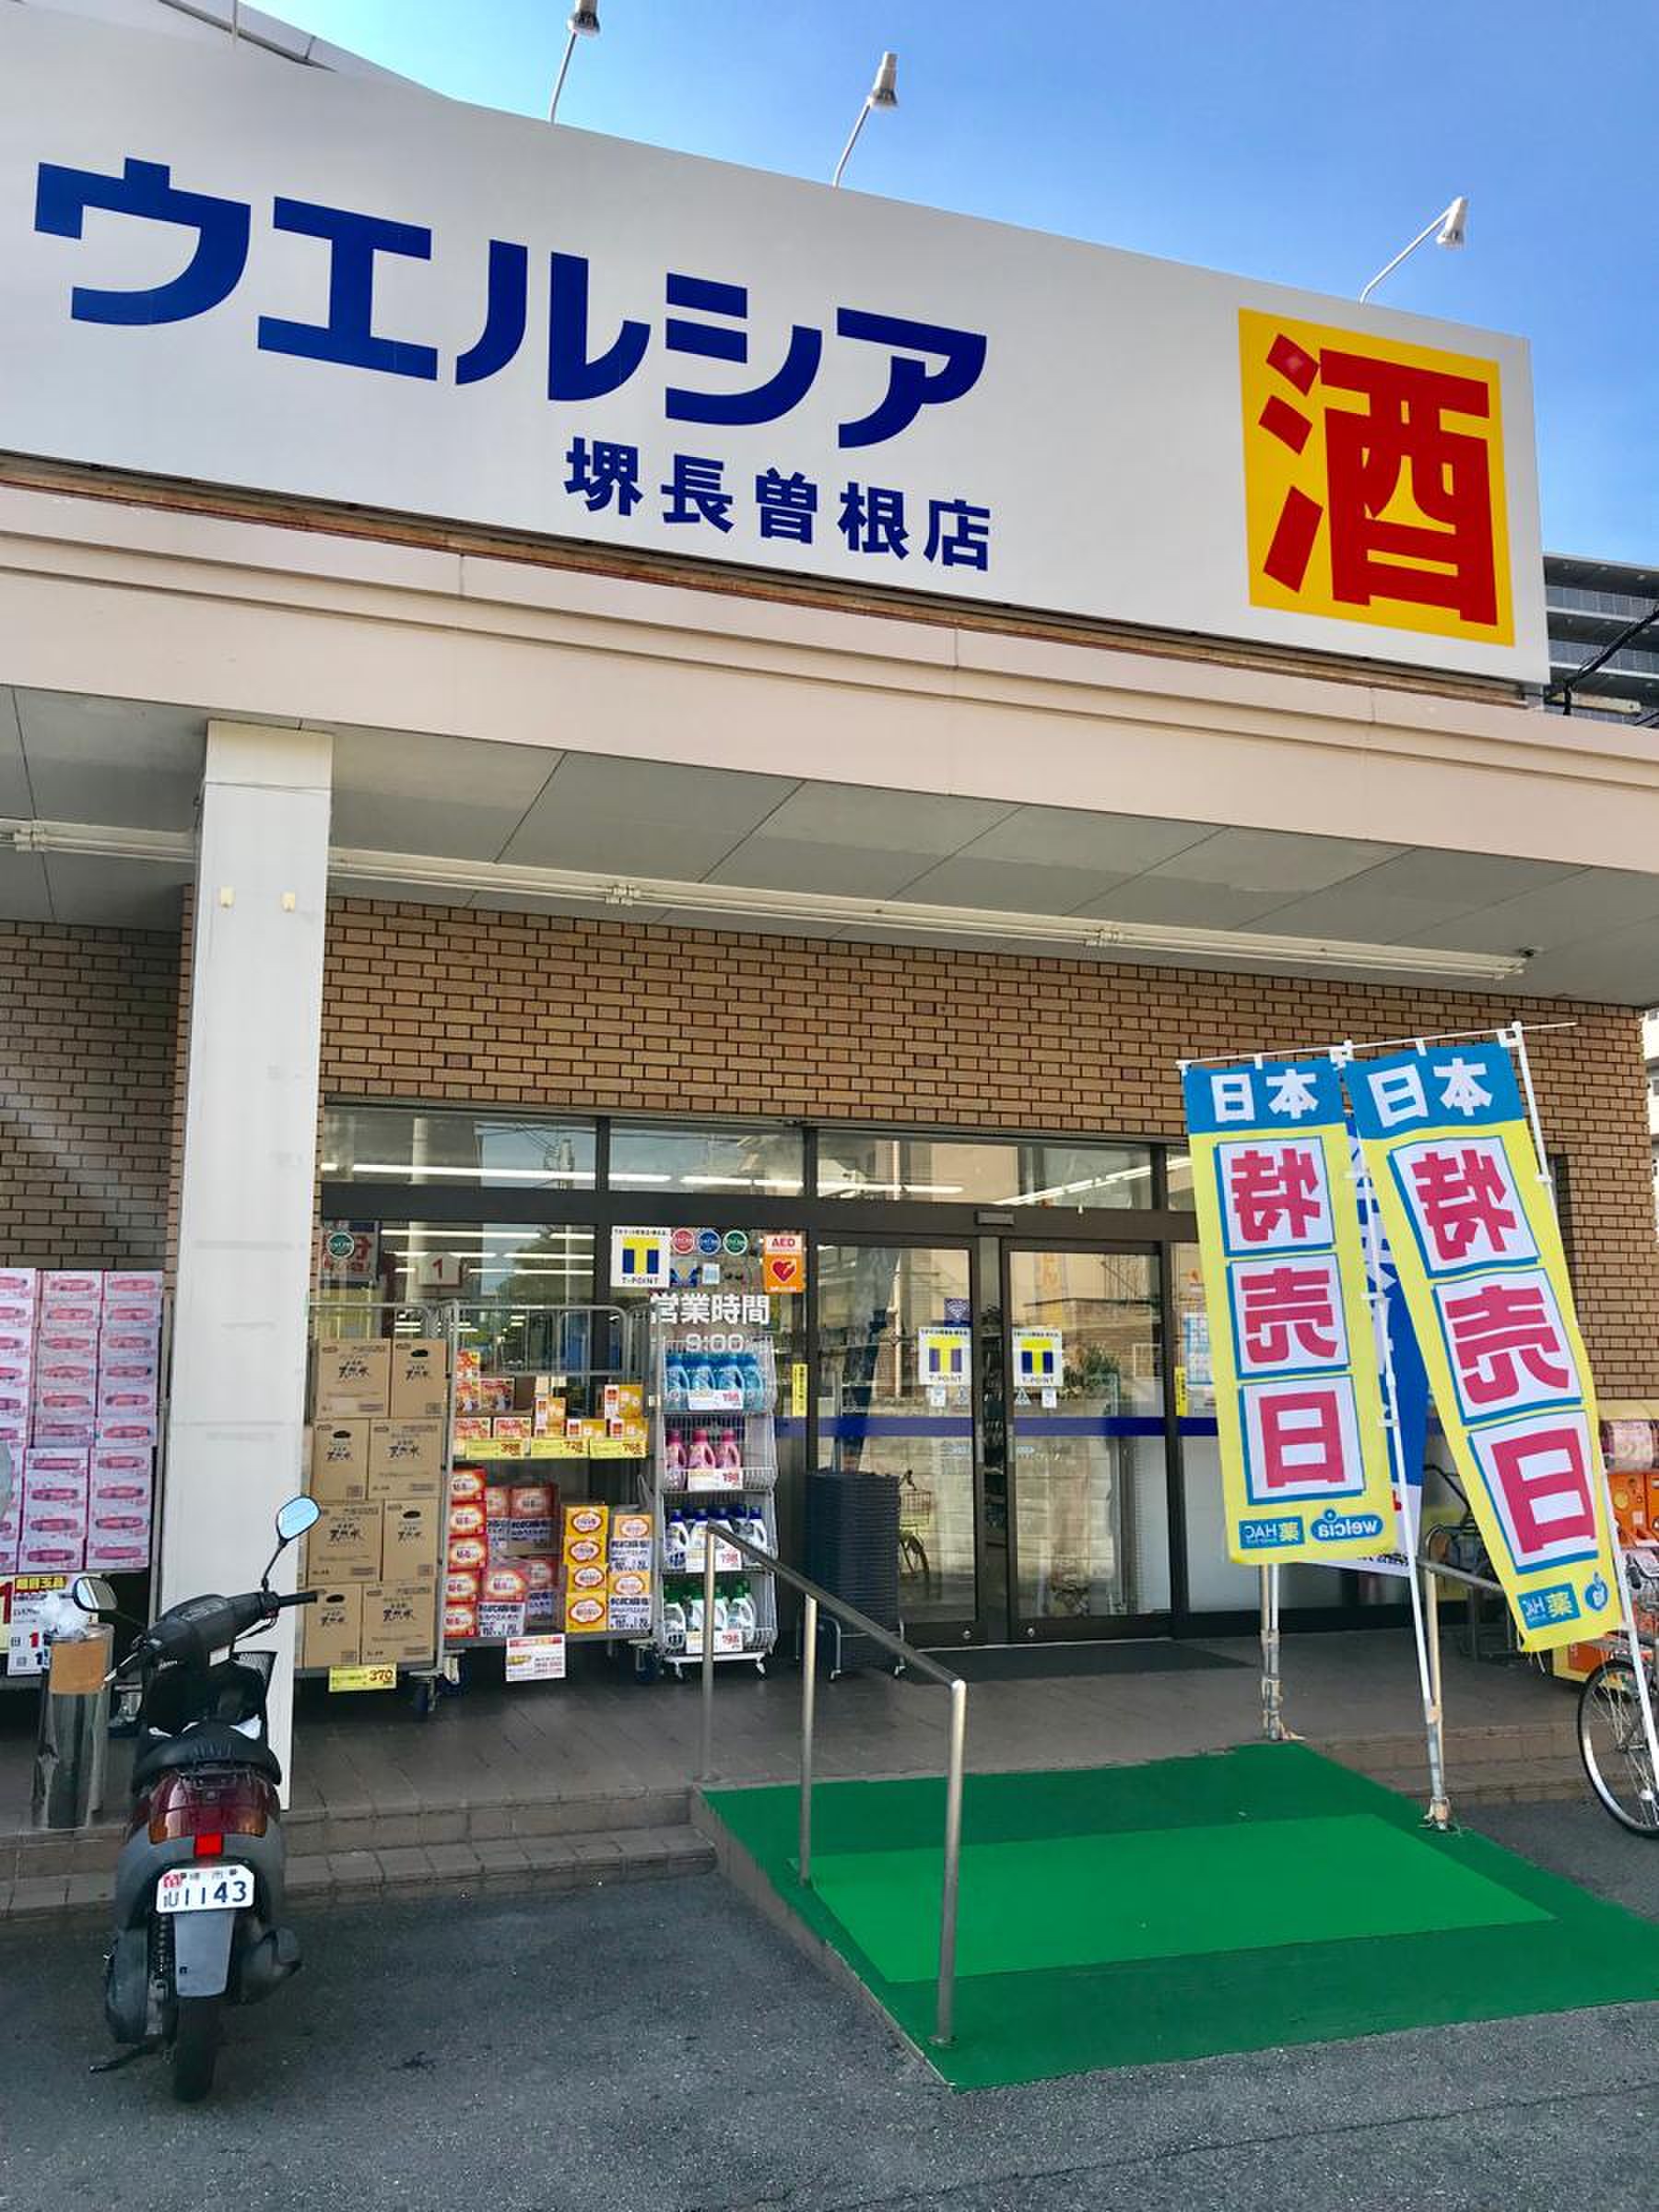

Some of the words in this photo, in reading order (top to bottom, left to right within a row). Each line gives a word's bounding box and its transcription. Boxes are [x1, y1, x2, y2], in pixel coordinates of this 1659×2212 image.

[35, 157, 987, 449] ウエルシア
[564, 438, 990, 571] 堺長曽根店
[1259, 334, 1498, 626] 酒
[772, 1238, 795, 1247] AED
[651, 1293, 771, 1324] 営業時間
[185, 1880, 246, 1906] 1143
